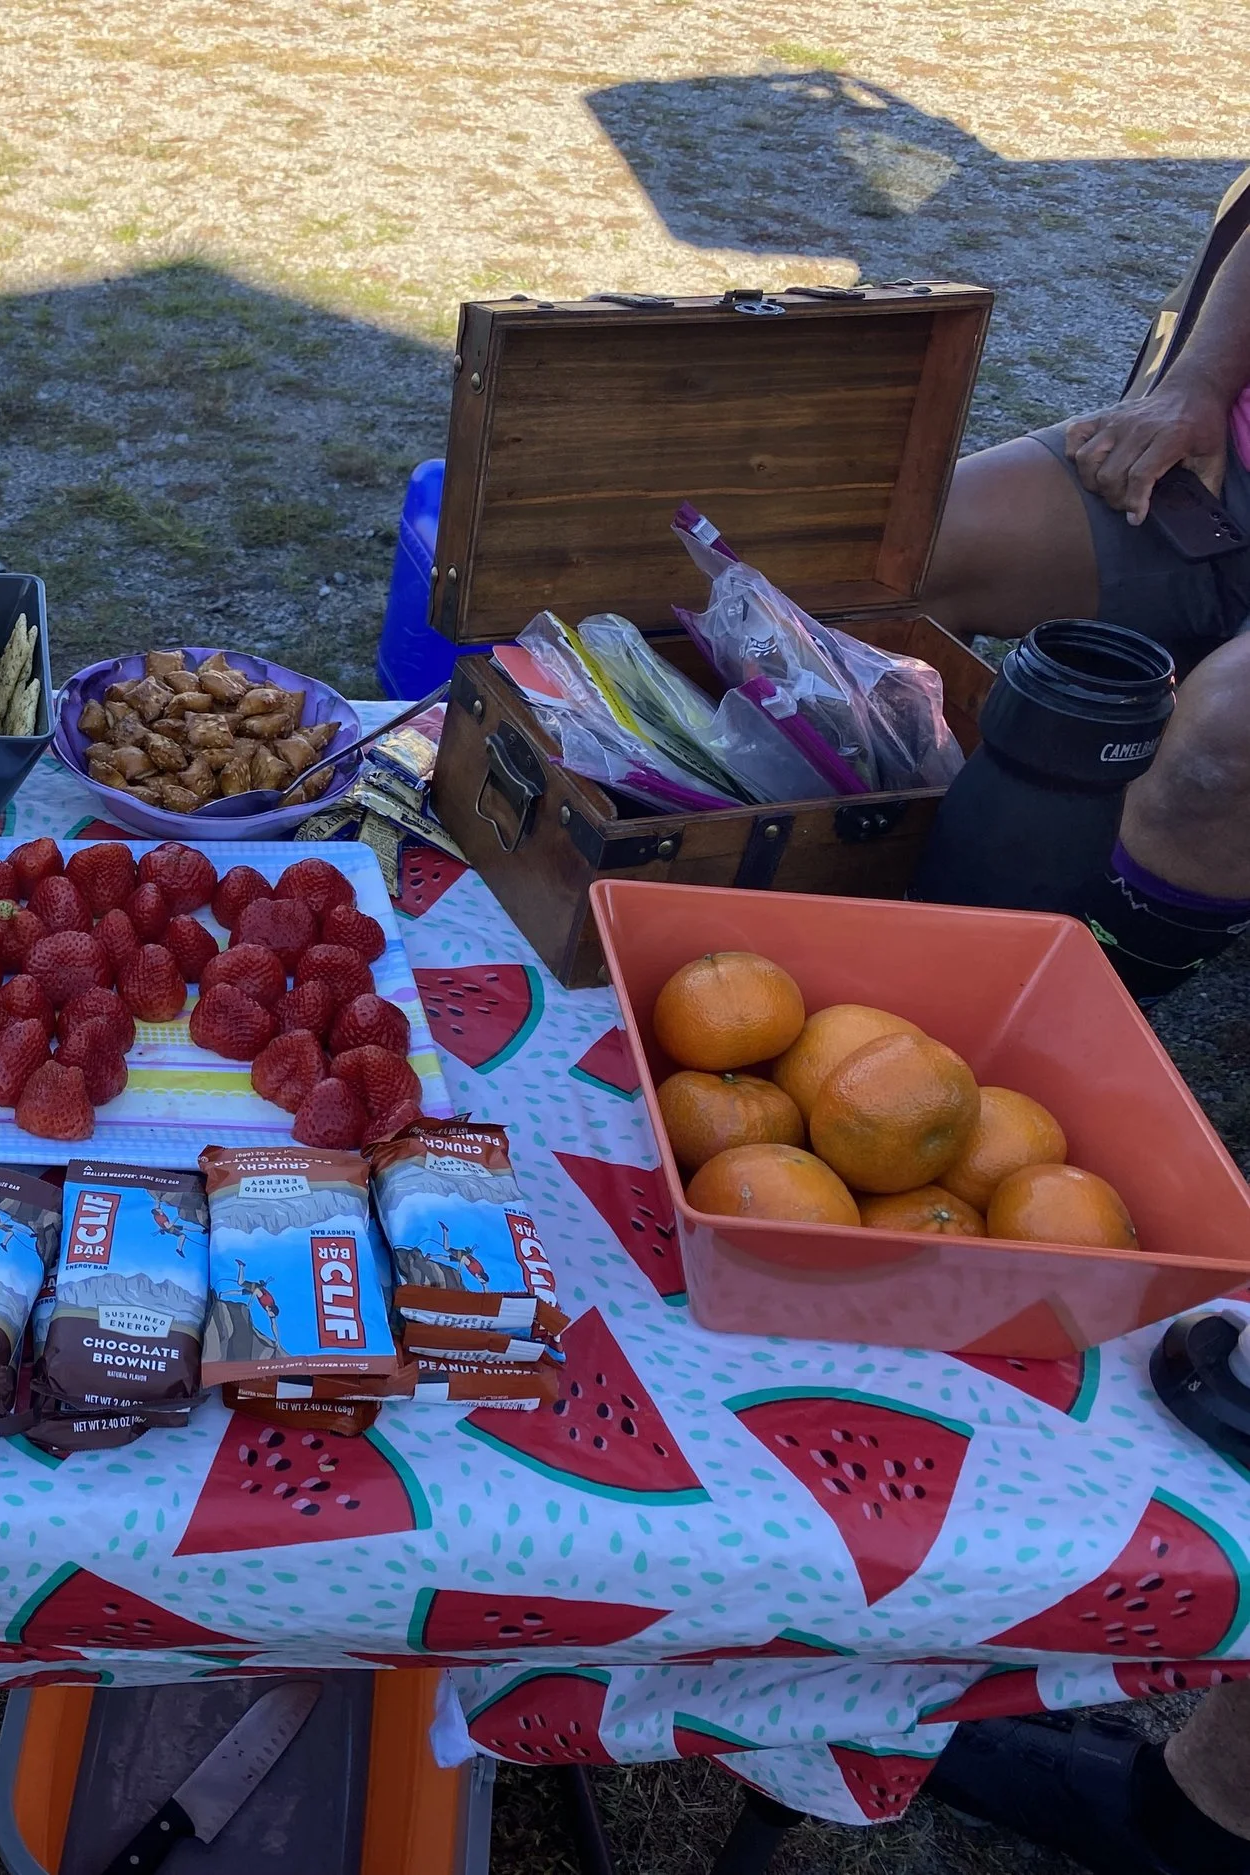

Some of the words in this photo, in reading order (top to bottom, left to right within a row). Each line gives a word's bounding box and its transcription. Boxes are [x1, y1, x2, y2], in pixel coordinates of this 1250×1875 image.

[451, 1133, 501, 1146] PEAN
[237, 1163, 310, 1171] CRUNCHY
[251, 1178, 298, 1186] ENERGY
[244, 1185, 304, 1194] SUSTAINED
[76, 1193, 113, 1245] CLIF
[73, 1244, 104, 1256] BAR
[318, 1247, 350, 1260] BAR
[320, 1260, 359, 1340] CLIF
[104, 1311, 166, 1326] SUSTAINED
[109, 1320, 158, 1334] ENERGY
[82, 1337, 180, 1360] CHOCOLATE
[92, 1352, 166, 1372] BROWNIE
[418, 1360, 479, 1374] PEANUT
[106, 1370, 128, 1380] NATURAL
[128, 1373, 147, 1382] FLAVOR
[85, 1394, 99, 1403] NET
[100, 1397, 111, 1406] WT
[276, 1401, 288, 1411] NET
[290, 1402, 301, 1411] WT
[304, 1402, 320, 1411] 2.40
[322, 1402, 333, 1412] OZ
[335, 1405, 355, 1416] (68g)
[73, 1421, 87, 1433] NET
[88, 1420, 100, 1431] WT
[101, 1418, 119, 1430] 2.40
[120, 1416, 131, 1428] OZ
